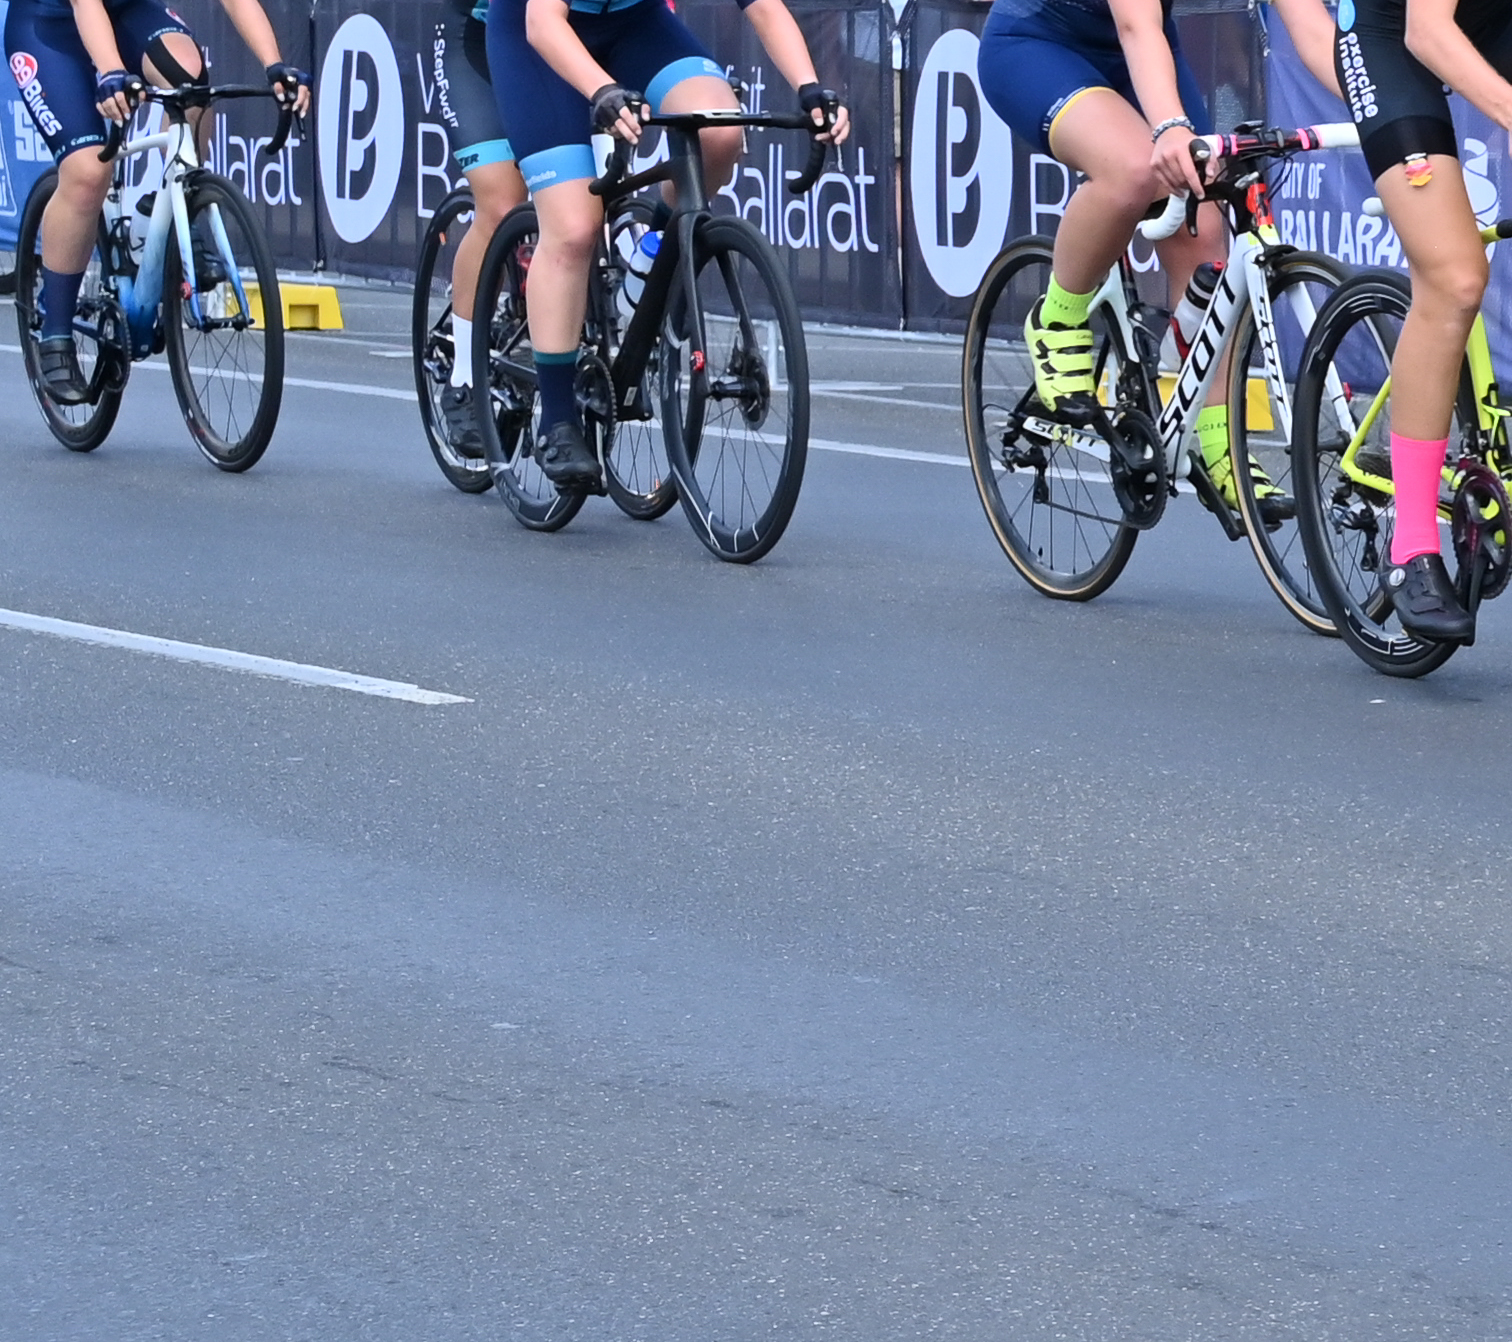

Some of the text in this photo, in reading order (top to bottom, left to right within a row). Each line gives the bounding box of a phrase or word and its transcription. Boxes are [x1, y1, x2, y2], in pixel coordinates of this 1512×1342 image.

[11, 53, 36, 89] 99
[1347, 32, 1379, 118] exercise
[1308, 162, 1326, 200] OF
[1280, 209, 1408, 267] BALLARA
[1159, 274, 1236, 449] SCOTT
